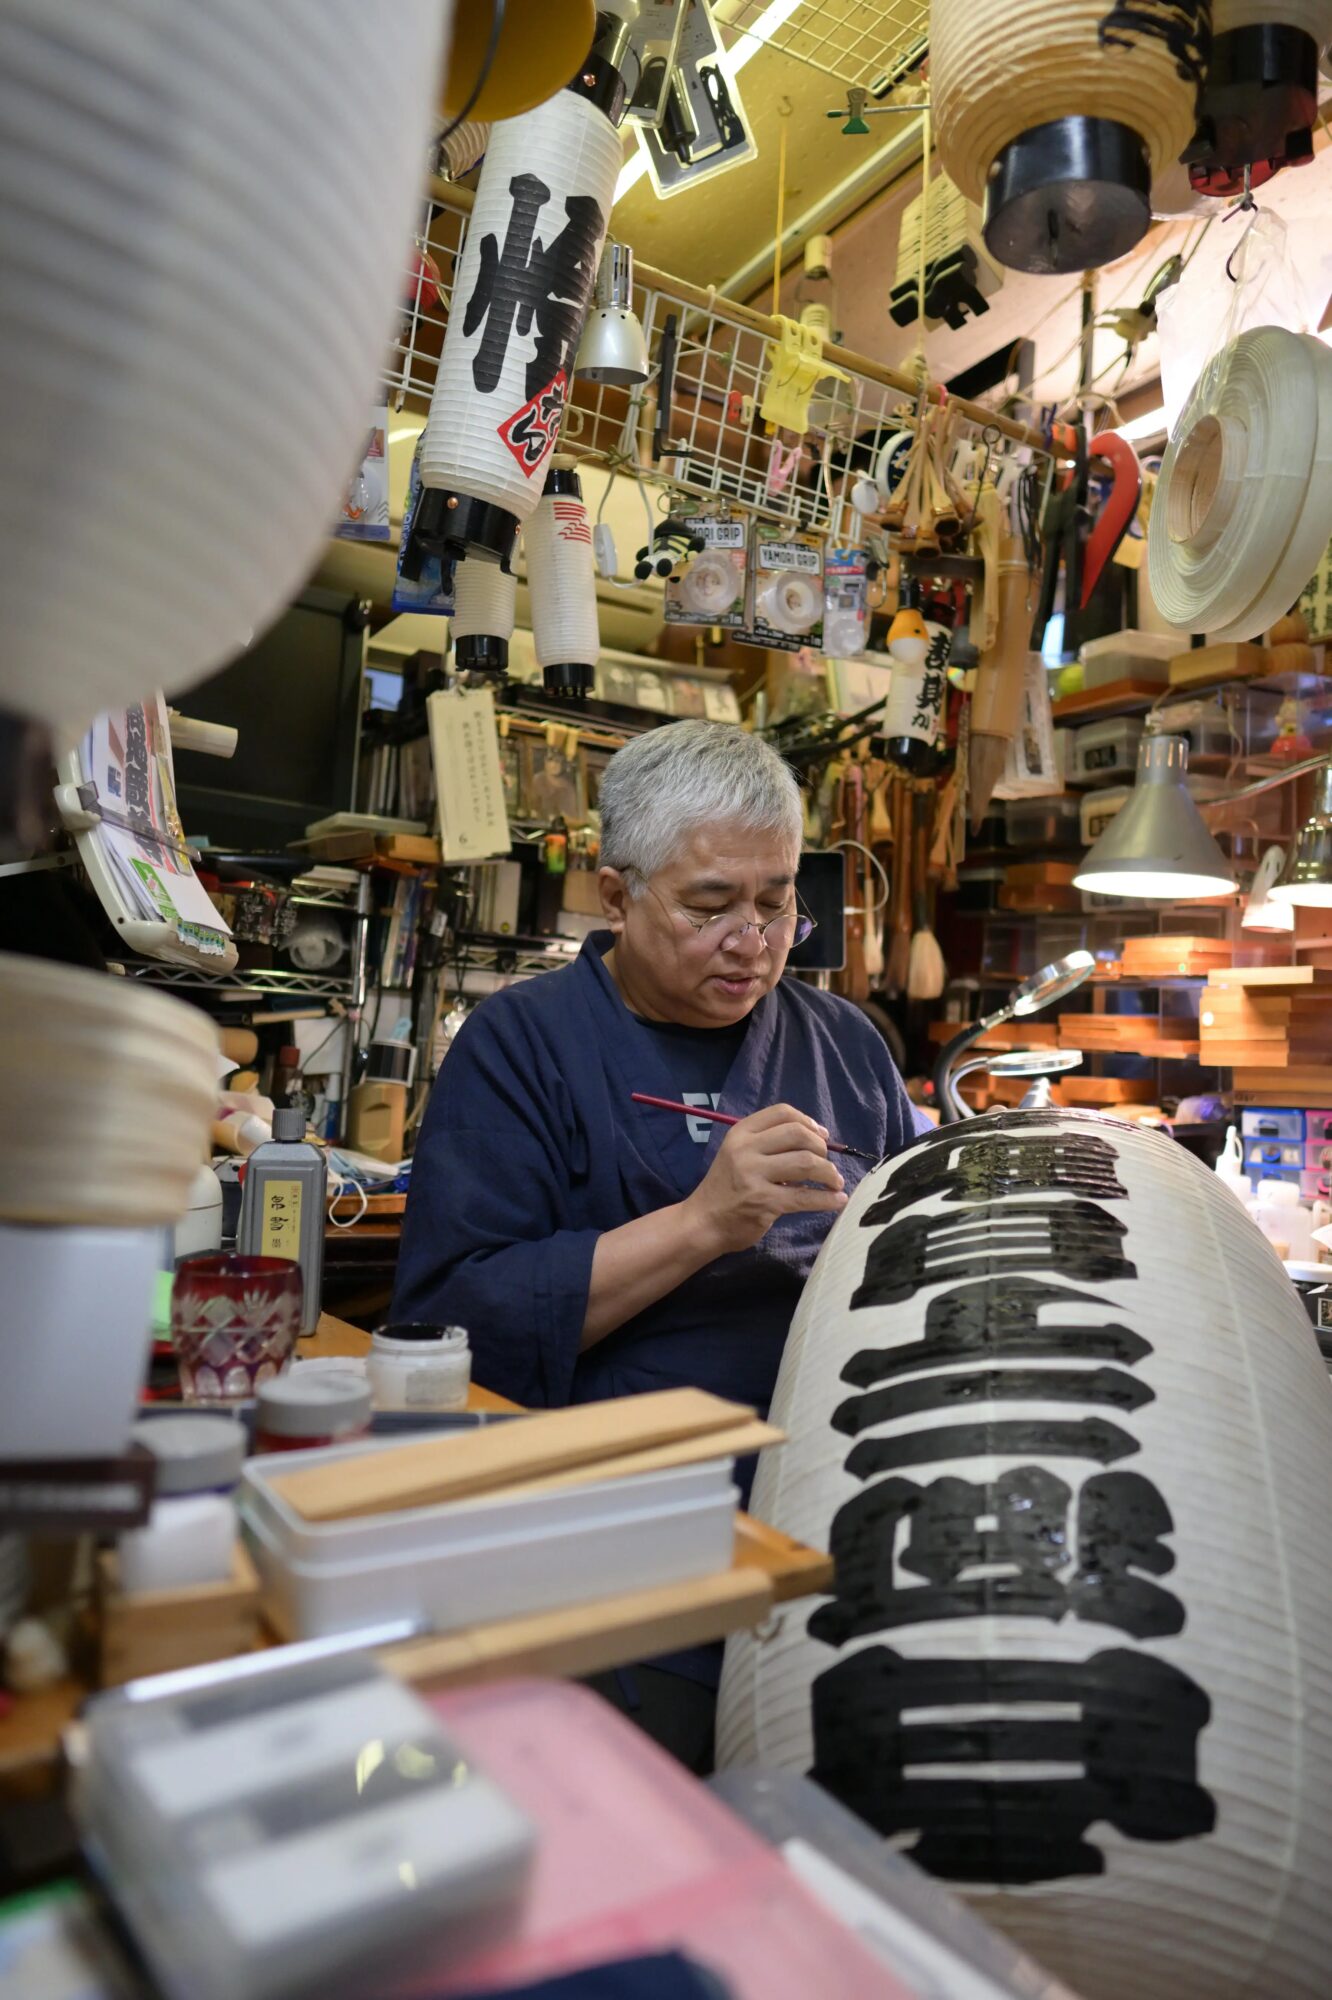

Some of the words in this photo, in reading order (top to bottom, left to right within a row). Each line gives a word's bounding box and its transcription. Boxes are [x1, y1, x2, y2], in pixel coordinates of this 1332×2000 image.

[716, 526, 742, 541] GRIP
[761, 548, 796, 567] YAMORI
[796, 553, 818, 568] GRIP
[807, 1107, 1217, 1885] 白河二丁目町
